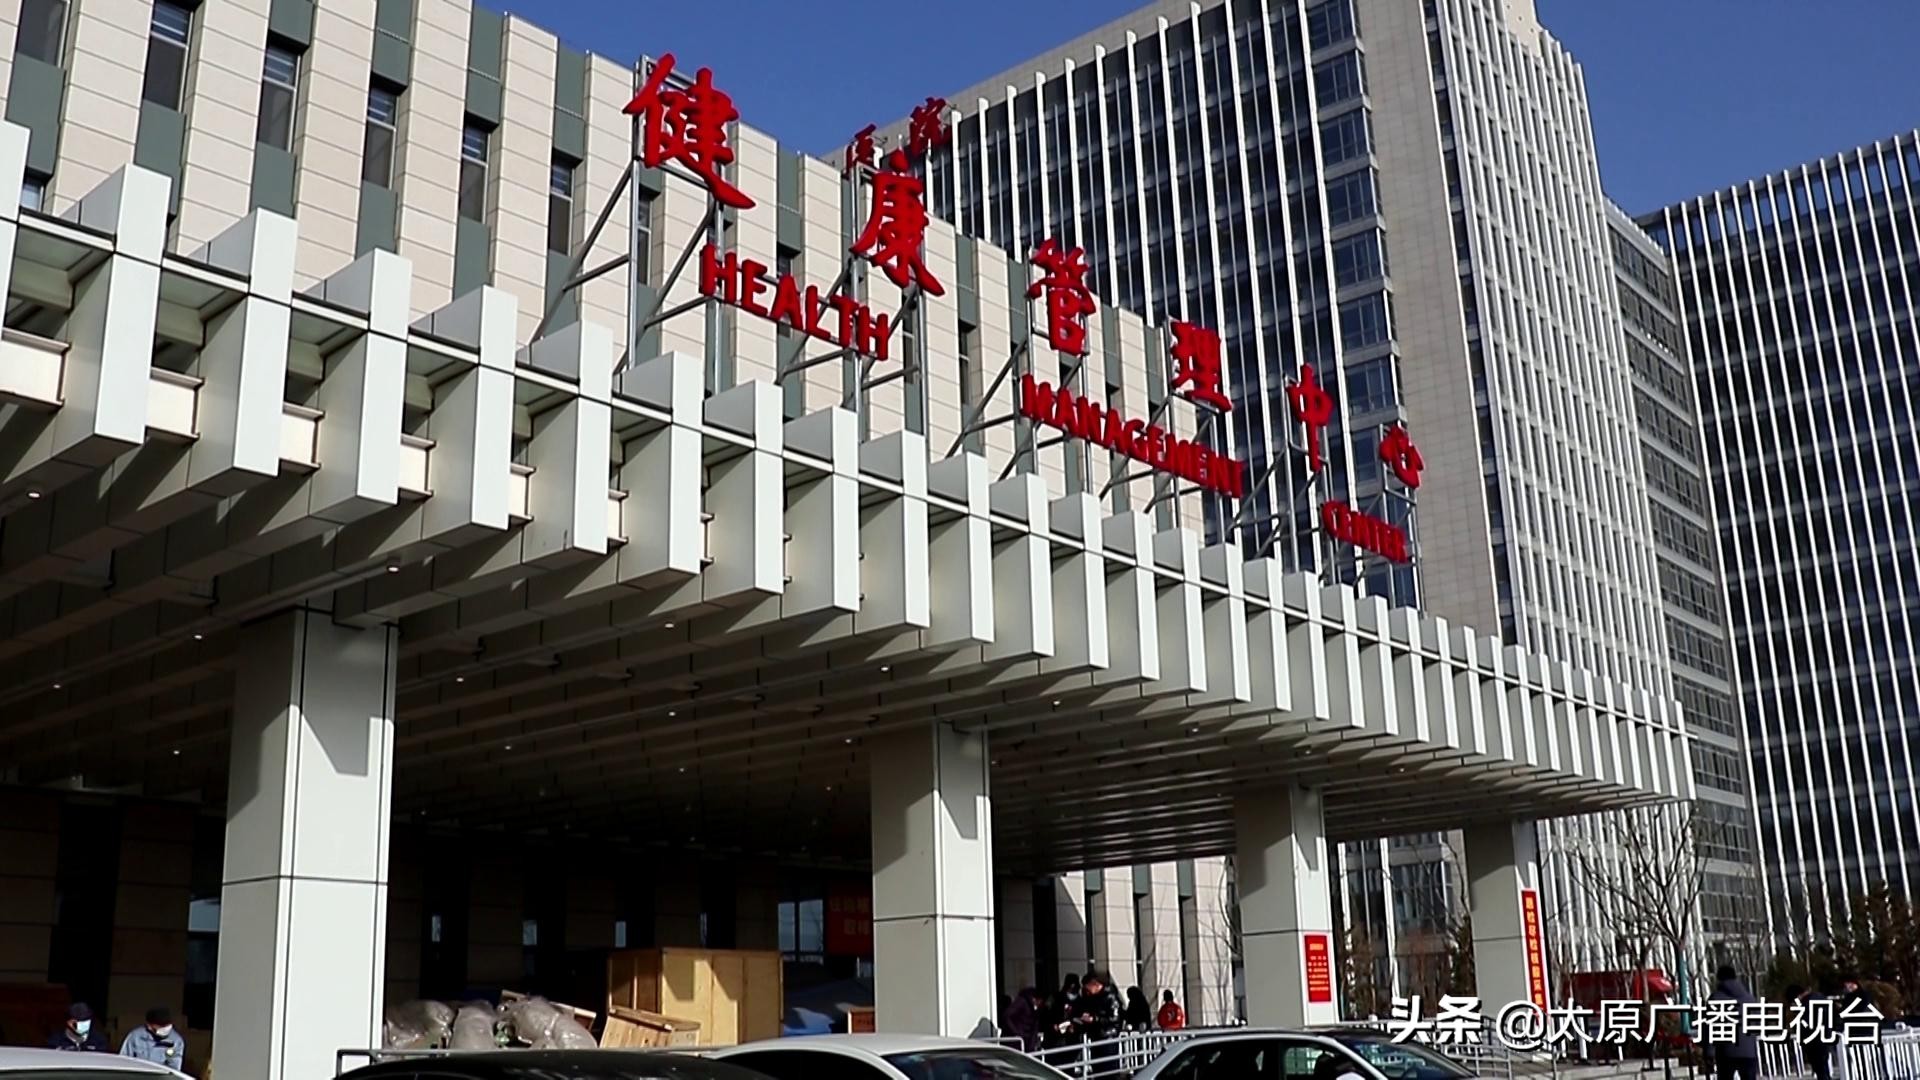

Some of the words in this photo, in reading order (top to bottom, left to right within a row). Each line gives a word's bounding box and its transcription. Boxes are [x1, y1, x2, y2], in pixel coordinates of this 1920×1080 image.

[622, 53, 1424, 489] 健康管理中心
[699, 243, 889, 361] HEALTH
[1020, 373, 1245, 499] MANAGEMENT
[1321, 500, 1409, 564] CENTER
